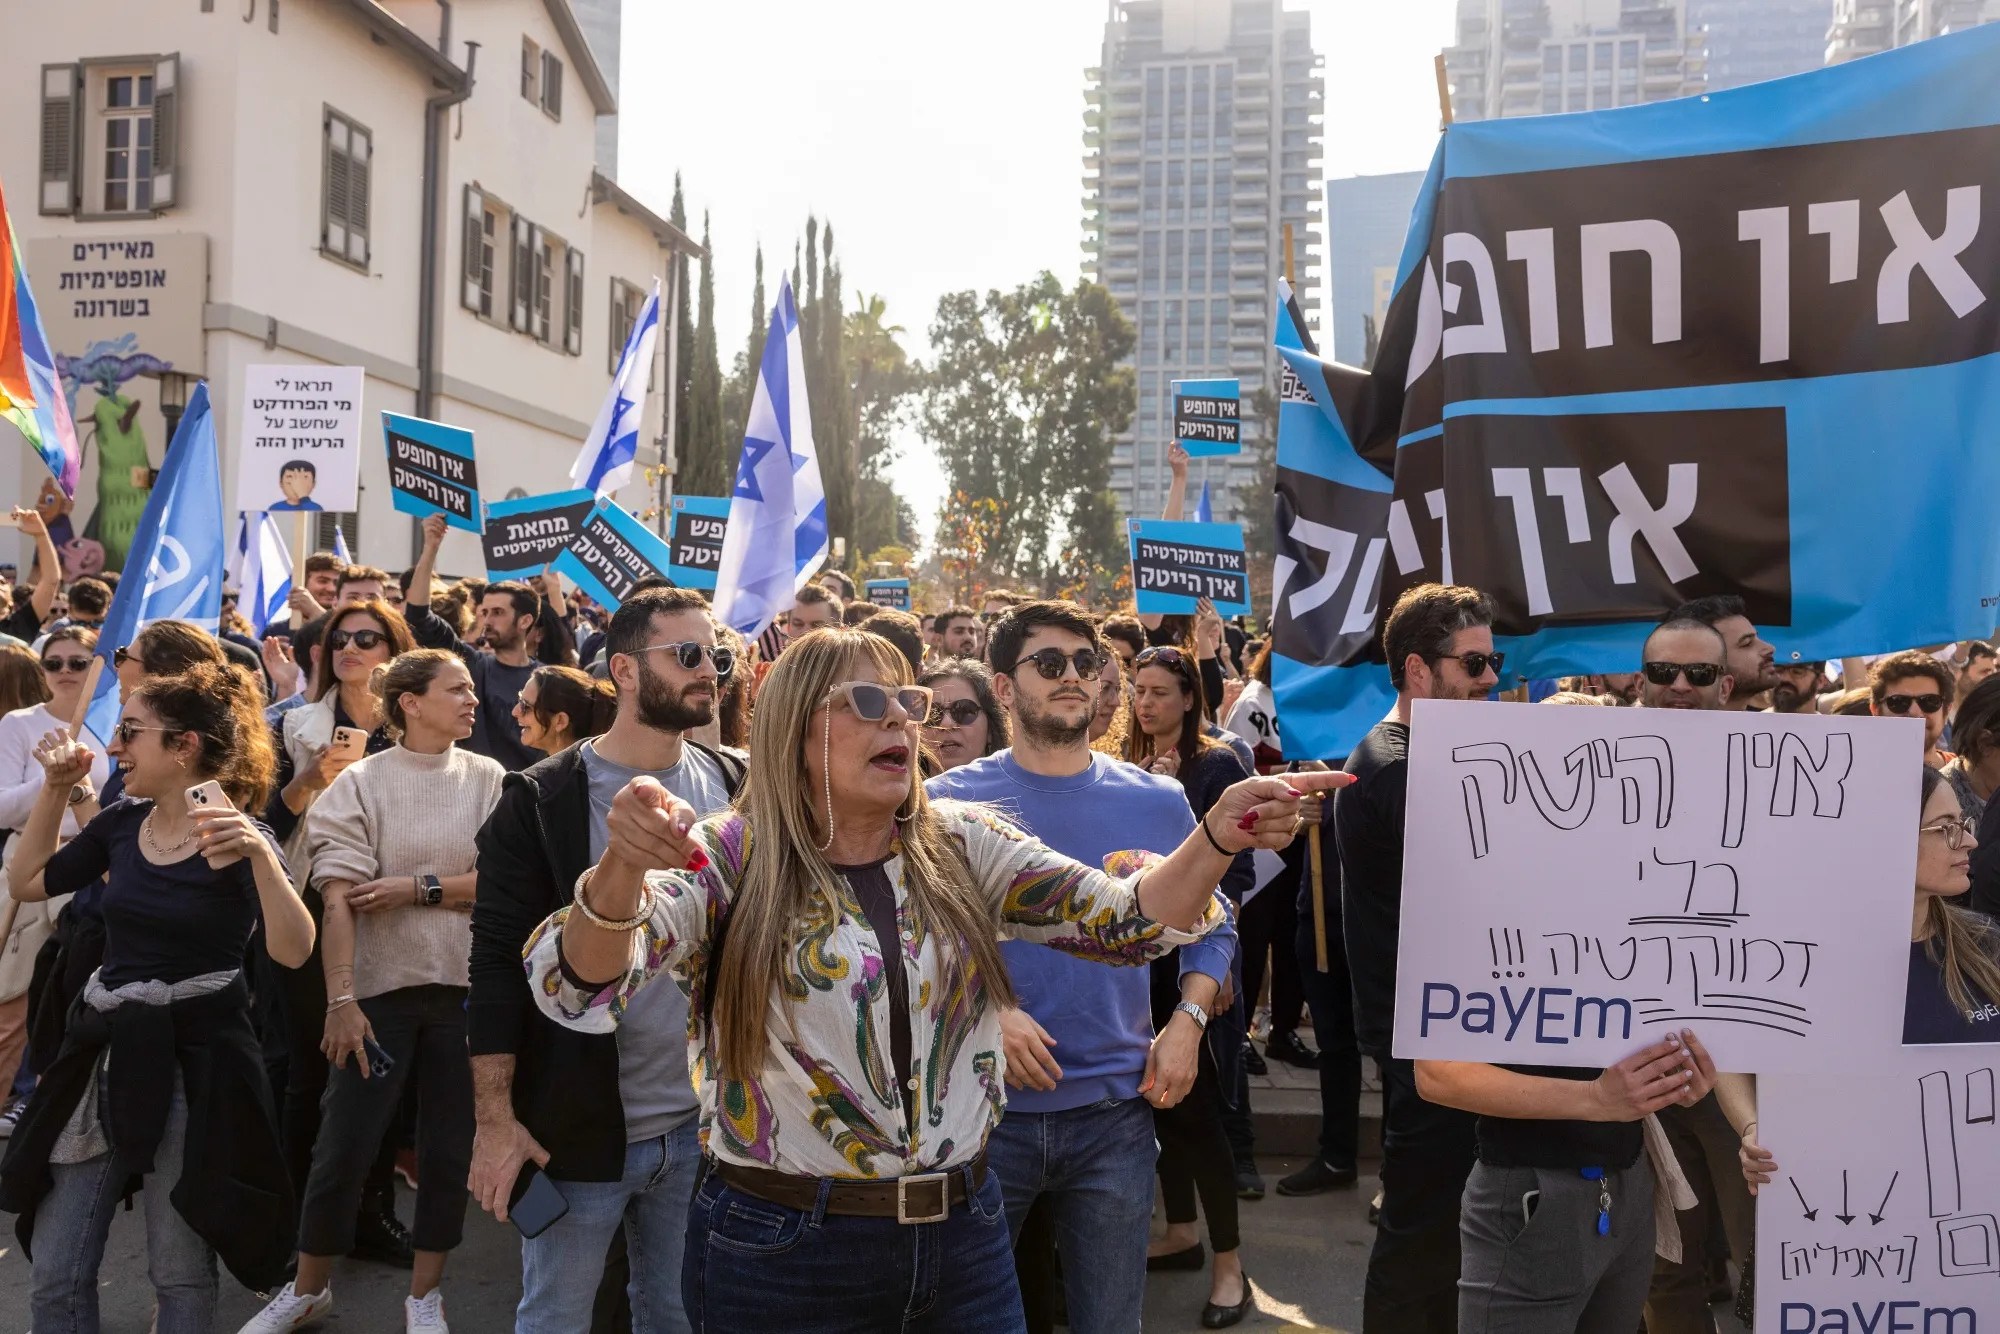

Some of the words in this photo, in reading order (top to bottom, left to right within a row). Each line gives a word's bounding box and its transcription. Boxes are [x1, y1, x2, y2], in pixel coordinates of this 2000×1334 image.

[73, 241, 154, 261] מאיירים
[59, 269, 166, 290] אופטימיות
[1737, 184, 1987, 365] אין
[74, 298, 150, 318] בשרונה
[275, 378, 289, 391] לי
[295, 380, 333, 392] תראו
[253, 399, 328, 412] הפרודקט
[333, 399, 351, 411] מי
[1183, 399, 1216, 415] חופש
[1217, 401, 1236, 418] אין
[264, 416, 284, 428] על
[289, 418, 338, 430] שחשב
[1179, 421, 1215, 438] הייטק
[256, 437, 286, 448] הזה
[1216, 424, 1235, 441] אין
[291, 437, 345, 450] הרעיון
[396, 440, 438, 471] חופש
[439, 454, 464, 480] אין
[394, 467, 439, 501] הייטק
[441, 486, 465, 513] אין
[506, 516, 570, 541] מחאת
[1492, 461, 1700, 617] אין
[570, 535, 623, 588] הייטק
[1142, 544, 1215, 565] דמוקרטיה
[1217, 553, 1240, 569] אין
[1140, 566, 1202, 593] הייטק
[1206, 575, 1237, 598] אין
[1721, 732, 1853, 848] אין
[1637, 847, 1750, 915] בלי
[1420, 982, 1632, 1045] PayEm
